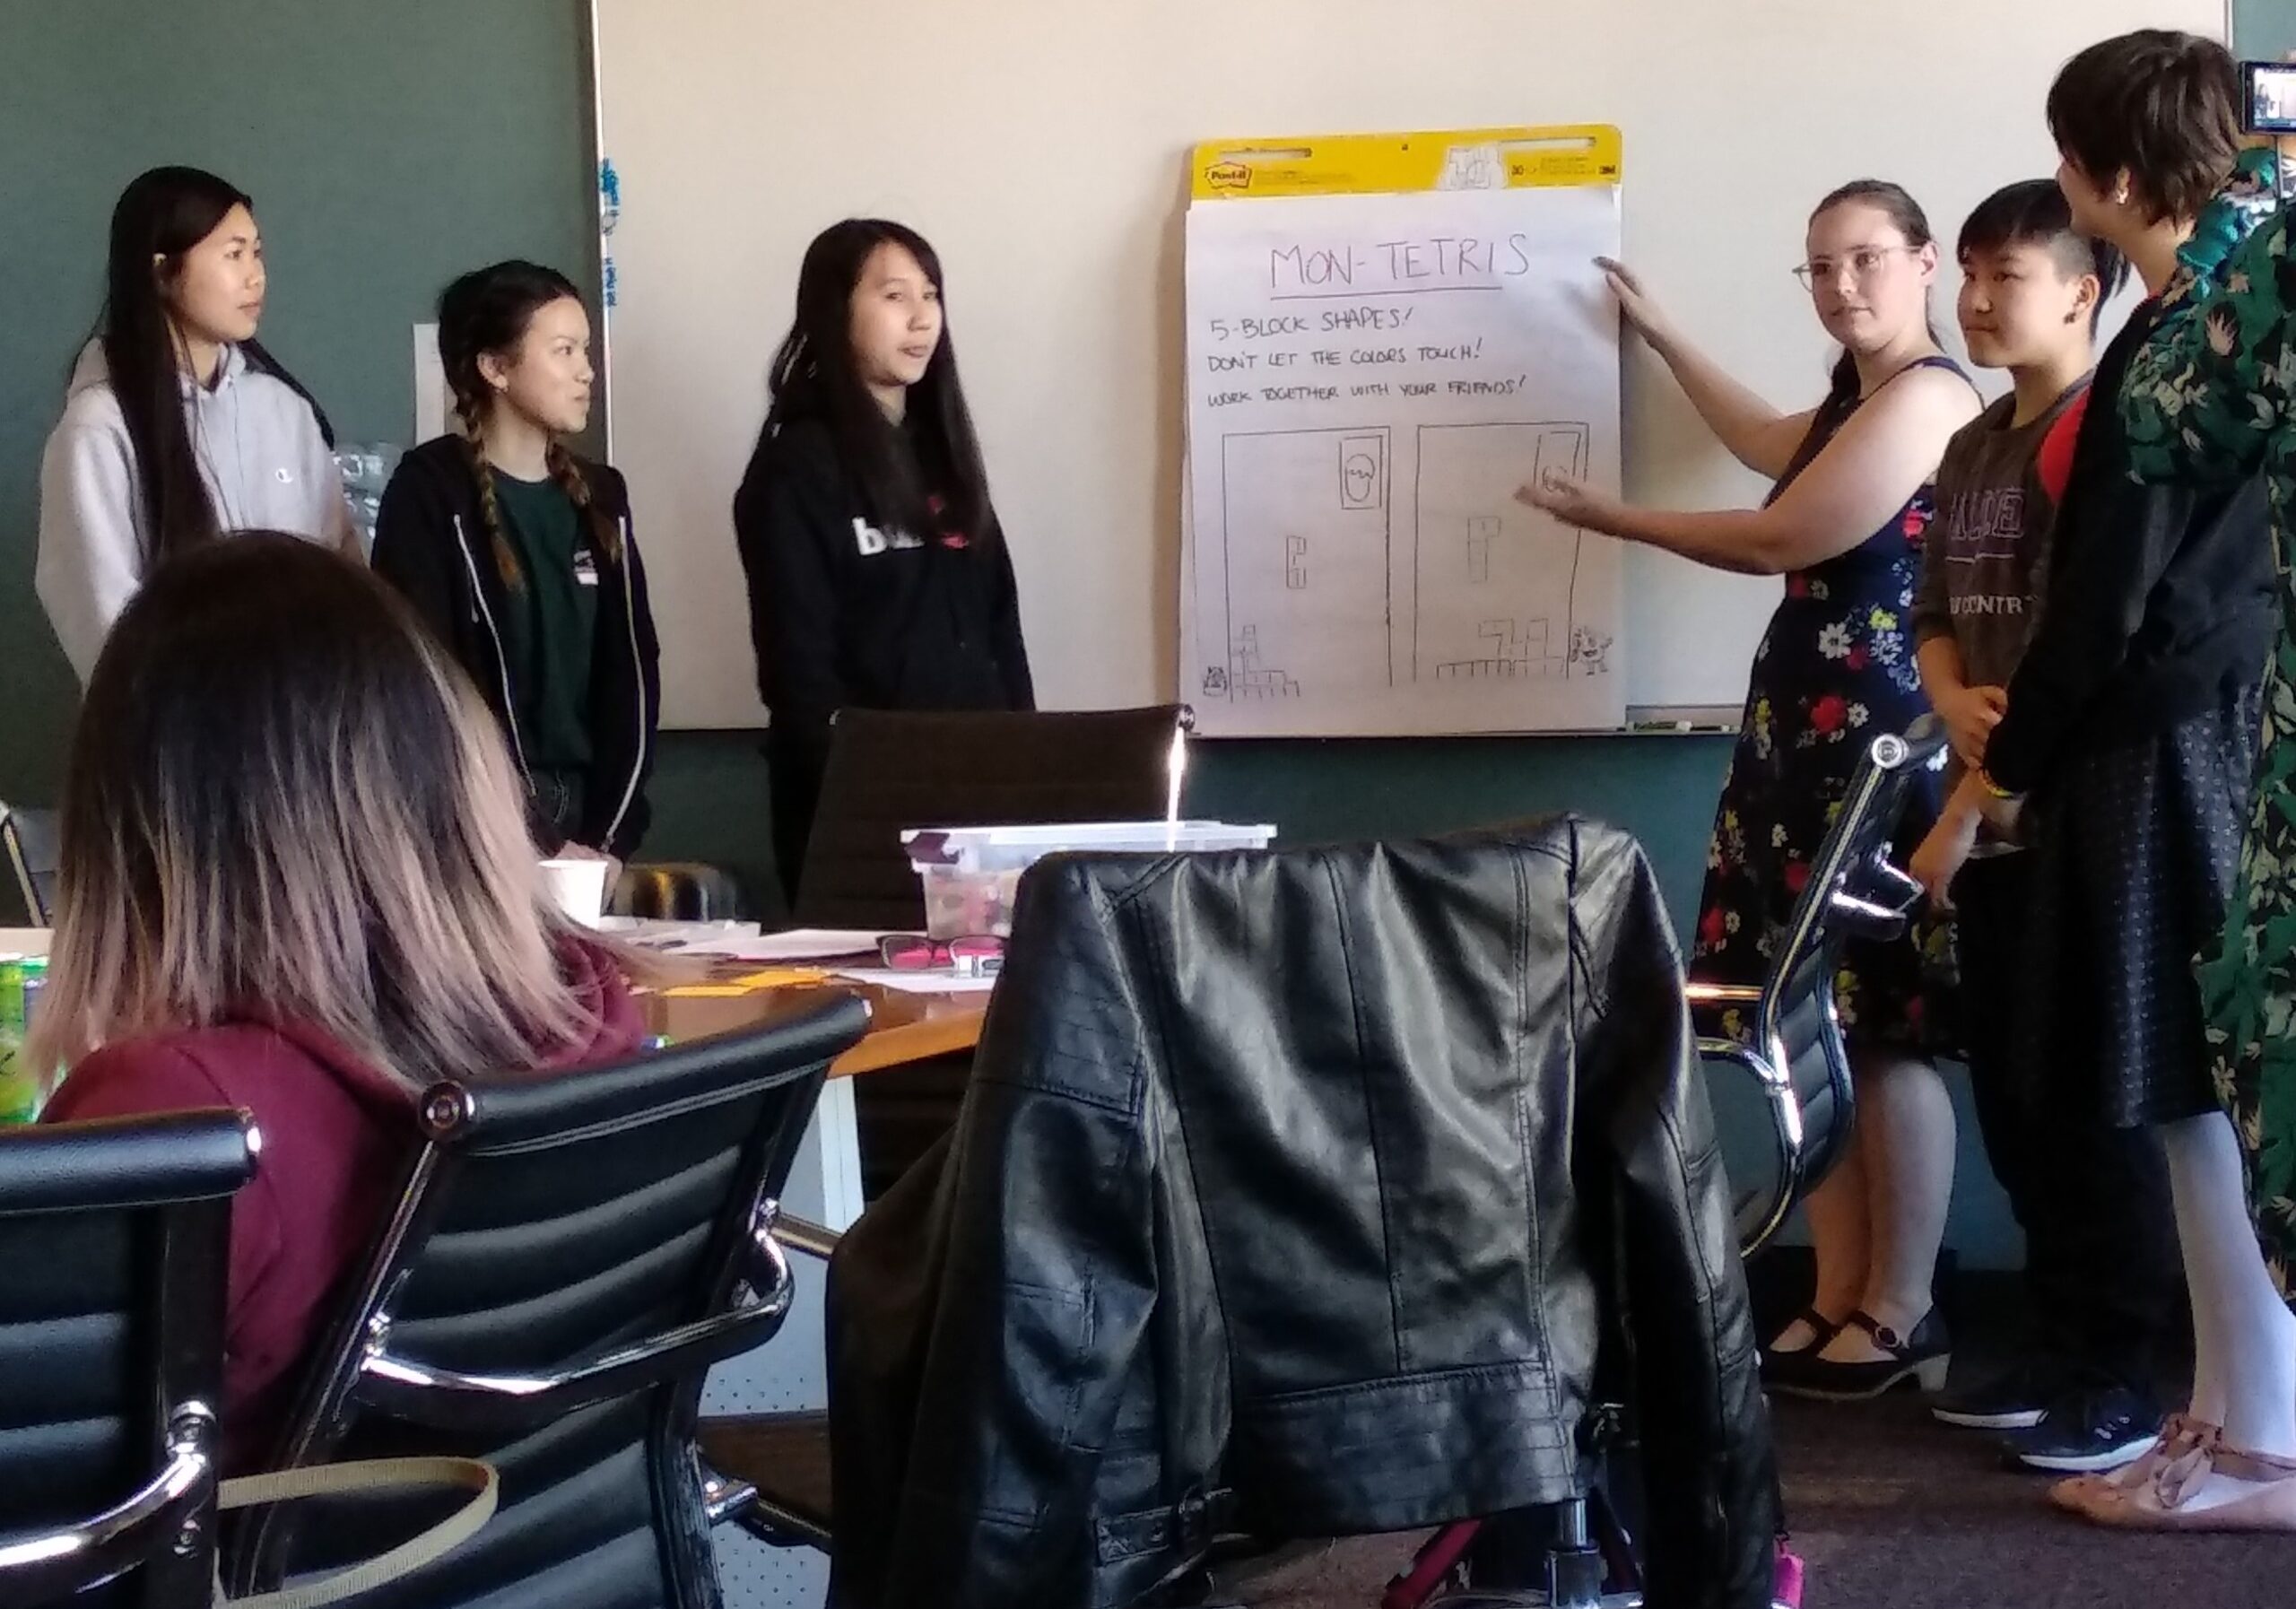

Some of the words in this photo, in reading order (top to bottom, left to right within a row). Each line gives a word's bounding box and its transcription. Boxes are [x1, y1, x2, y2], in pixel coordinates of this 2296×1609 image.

[1320, 306, 1414, 332] SHAPES!
[1207, 351, 1257, 372] DON'T
[1268, 352, 1298, 366] LET
[1310, 351, 1342, 365] THE
[1350, 348, 1406, 364] COLORS
[1417, 336, 1483, 361] TOUCH!
[1207, 391, 1253, 407] WORK
[1260, 386, 1339, 401] TOGETHER
[1350, 383, 1389, 397] WITH
[1399, 382, 1437, 396] YOUR
[1448, 374, 1526, 396] FRIENDS!
